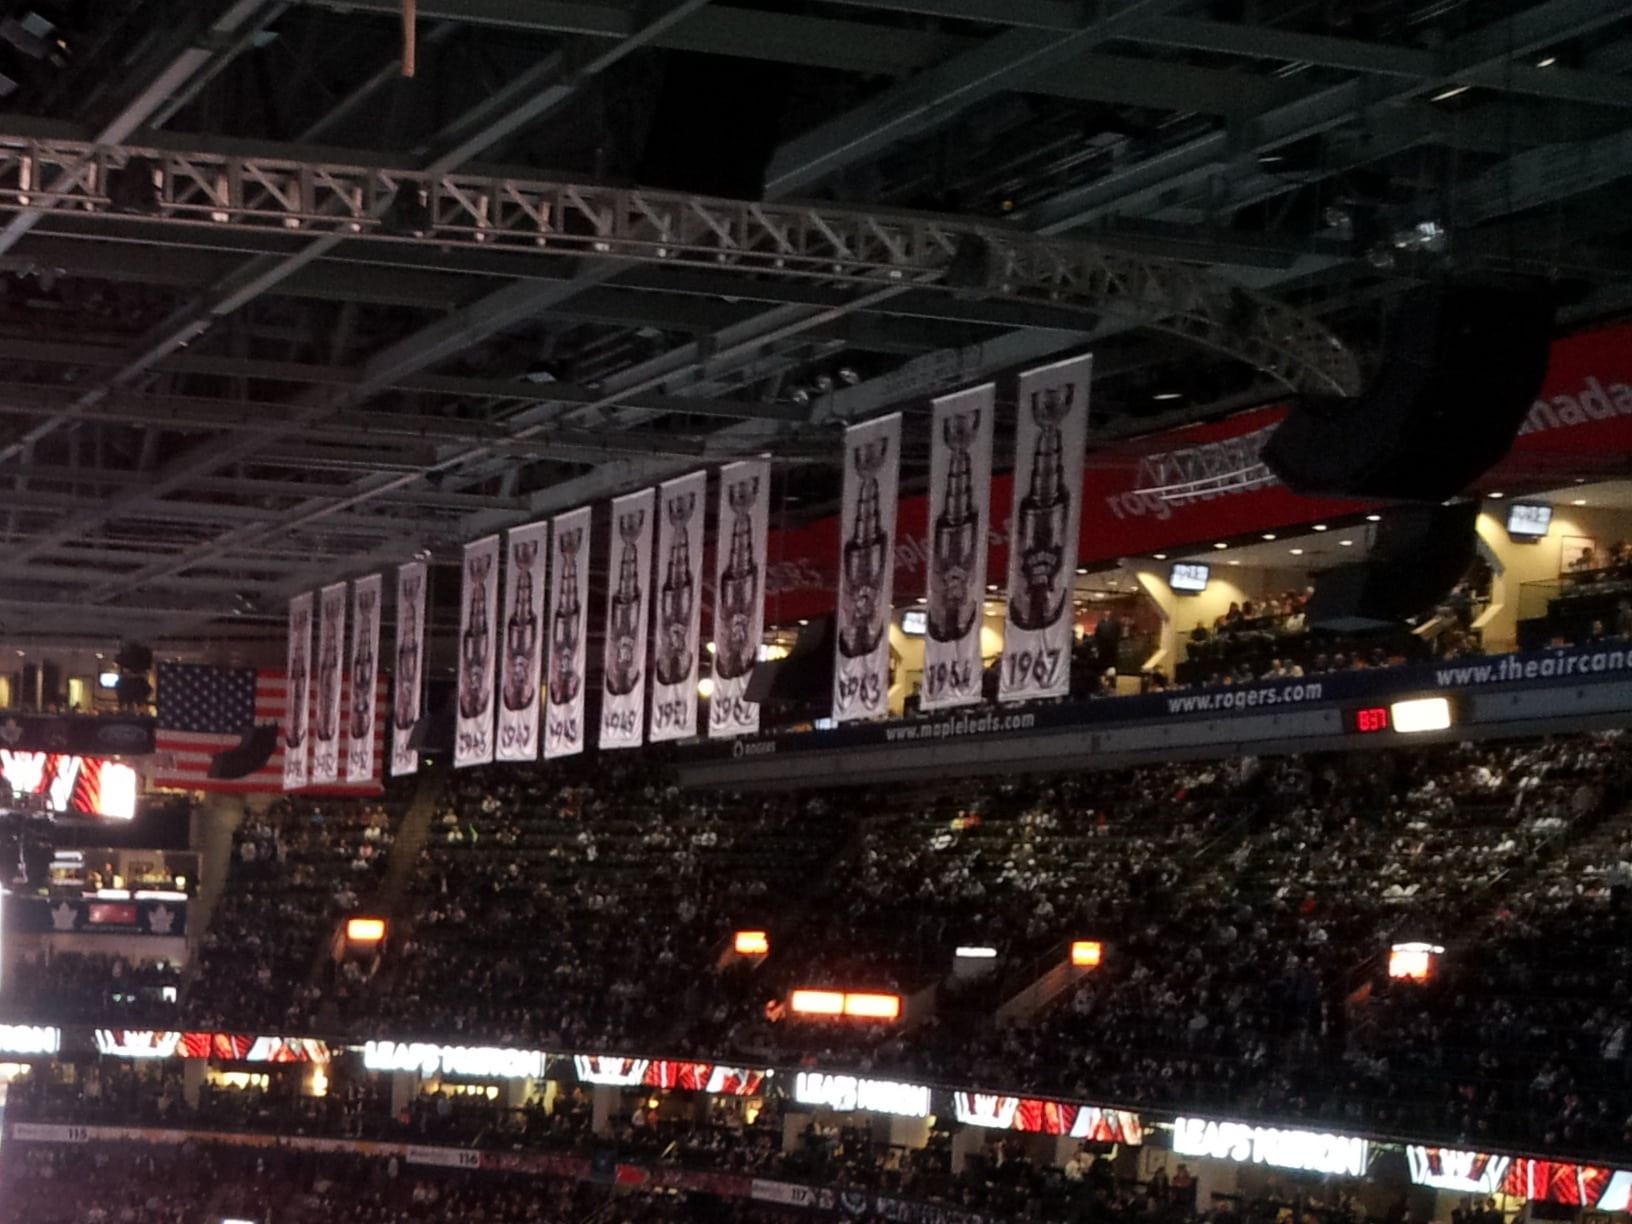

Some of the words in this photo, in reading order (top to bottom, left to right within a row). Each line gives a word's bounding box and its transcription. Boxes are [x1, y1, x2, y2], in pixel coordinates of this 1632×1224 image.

[1518, 375, 1632, 435] nada
[1009, 650, 1060, 688] 1967
[1167, 681, 1323, 714] www.rogers.com
[886, 712, 1036, 741] www.mapleleafs.com
